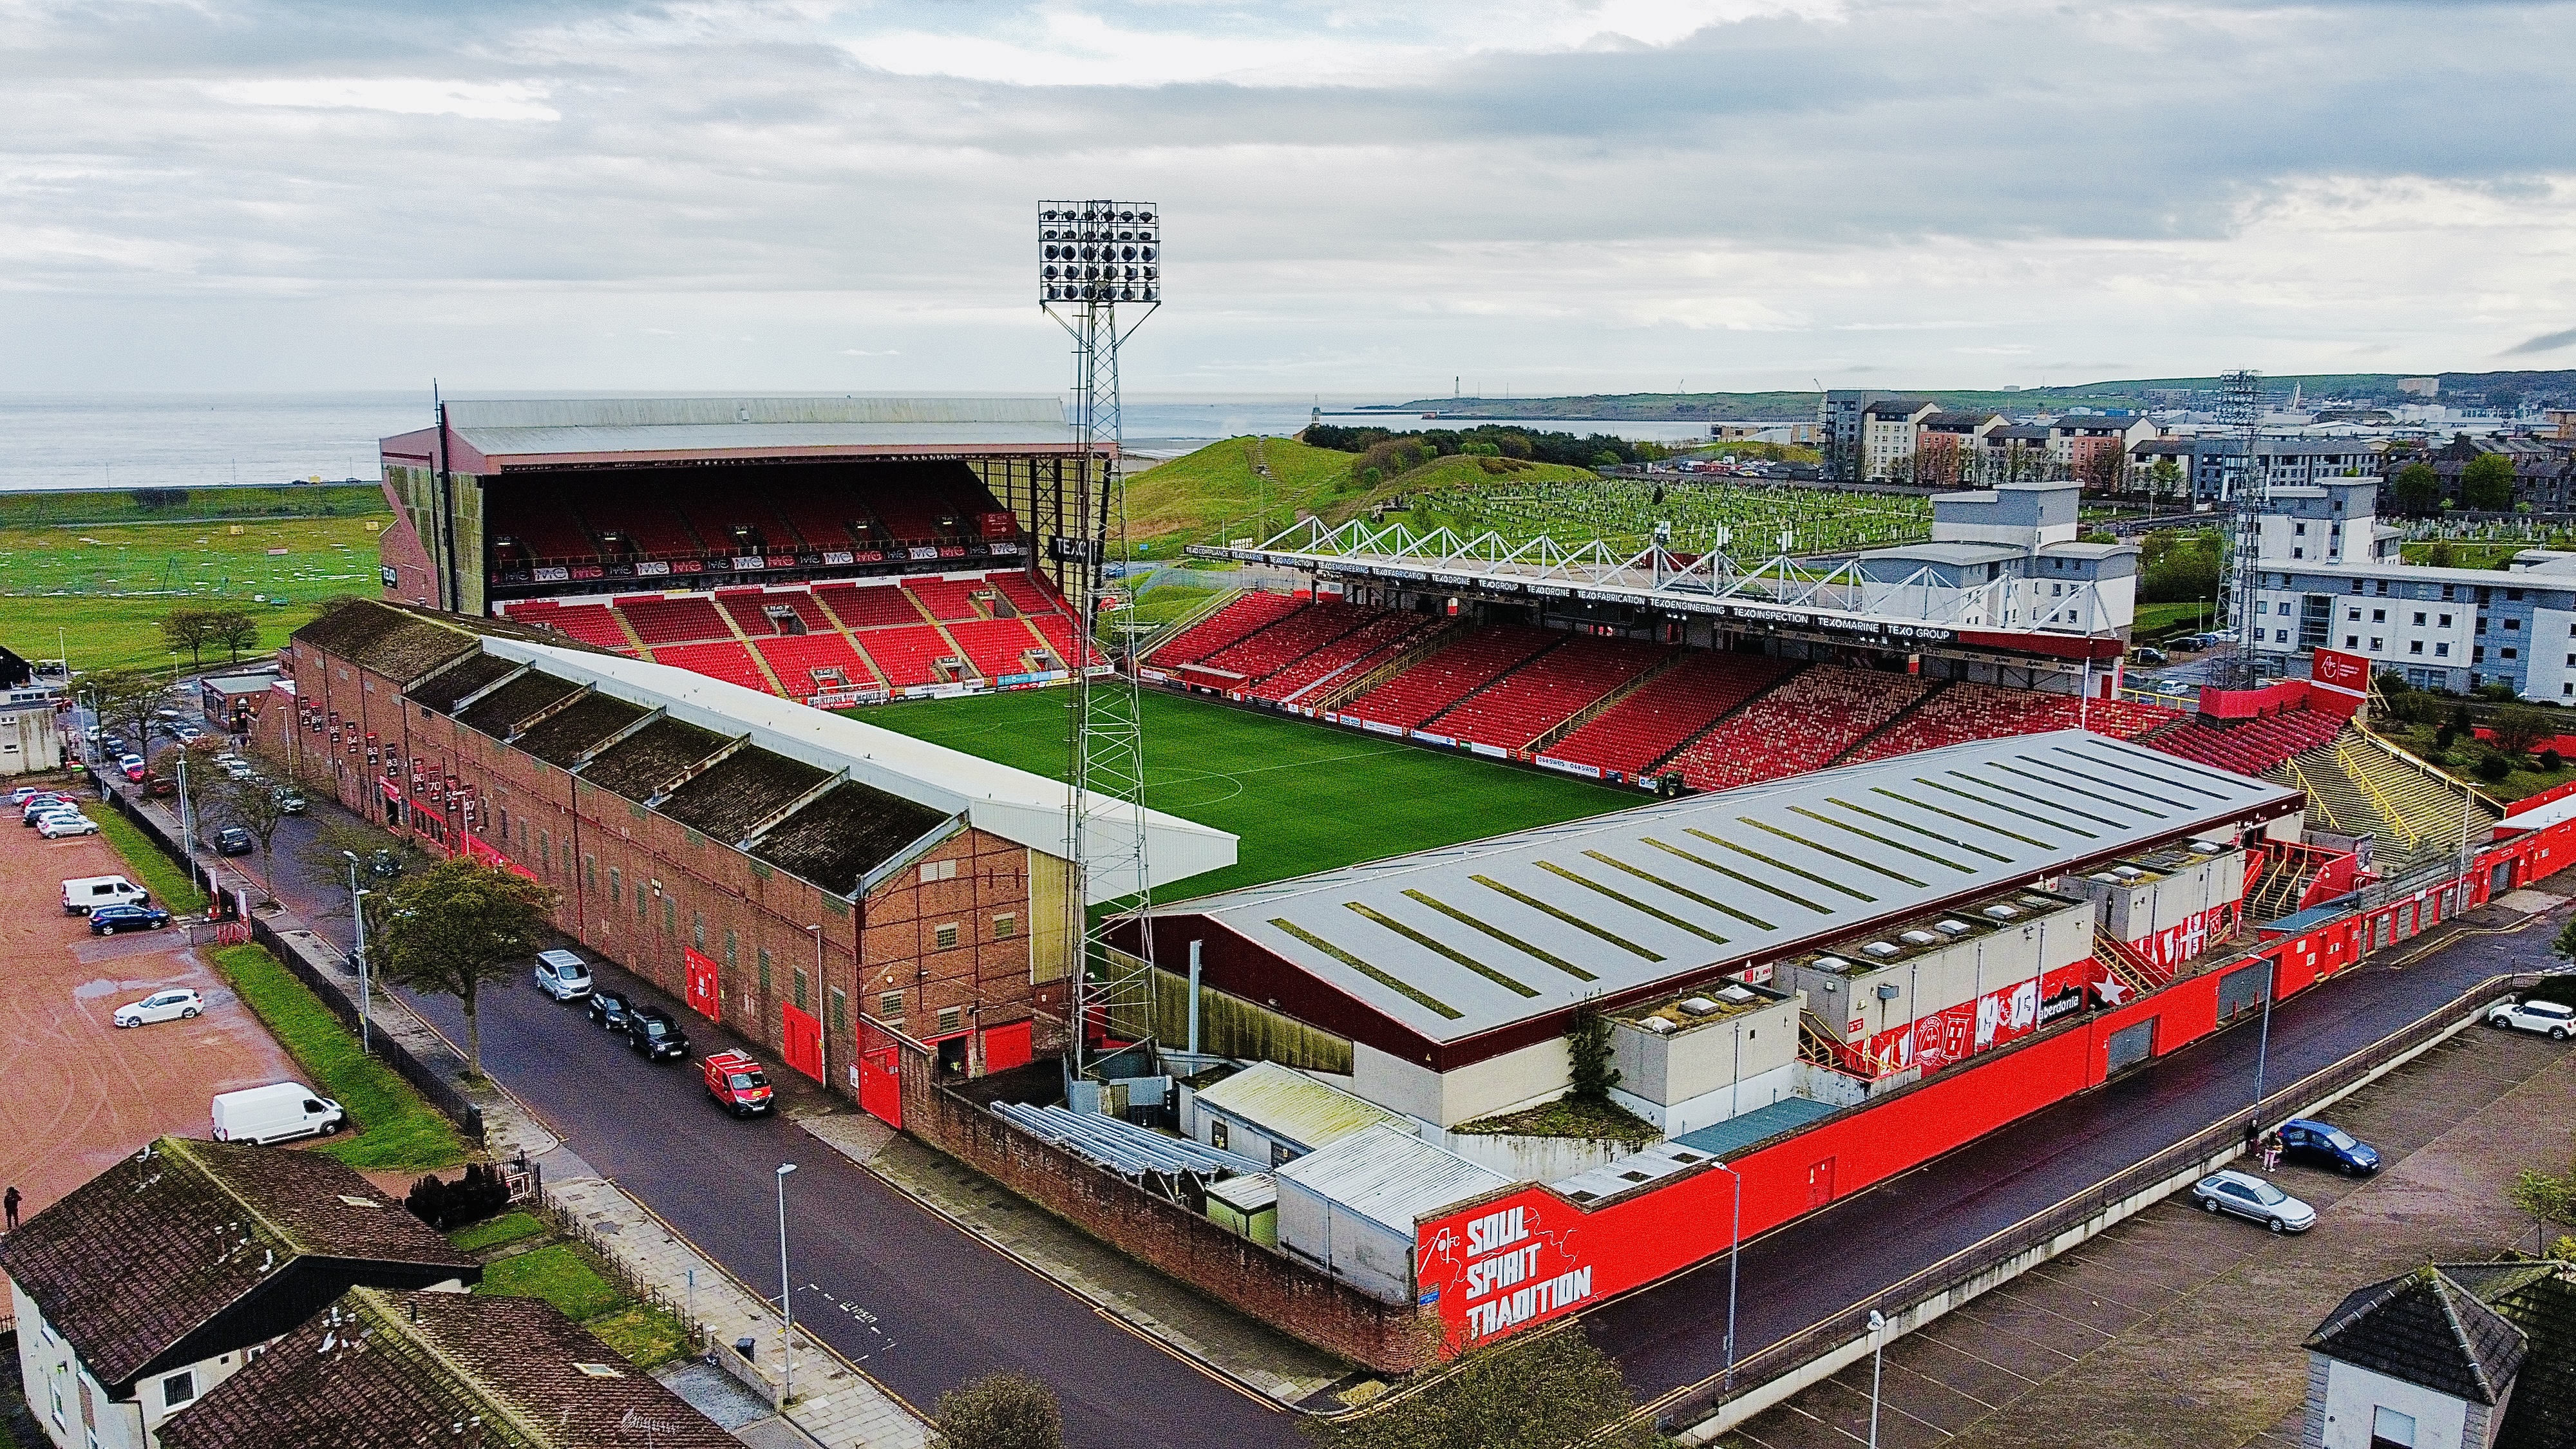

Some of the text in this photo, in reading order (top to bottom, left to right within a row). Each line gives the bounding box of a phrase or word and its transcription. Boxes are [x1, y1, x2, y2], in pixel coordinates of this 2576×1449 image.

[1887, 625, 1950, 640] TEXO GROUP
[413, 773, 424, 782] 80
[429, 782, 440, 791] 70
[2039, 995, 2079, 1021] aberdonia
[1467, 1205, 1530, 1258] SOUL
[1466, 1242, 1542, 1300] SPIRIT
[1466, 1264, 1593, 1340] TRADITION
